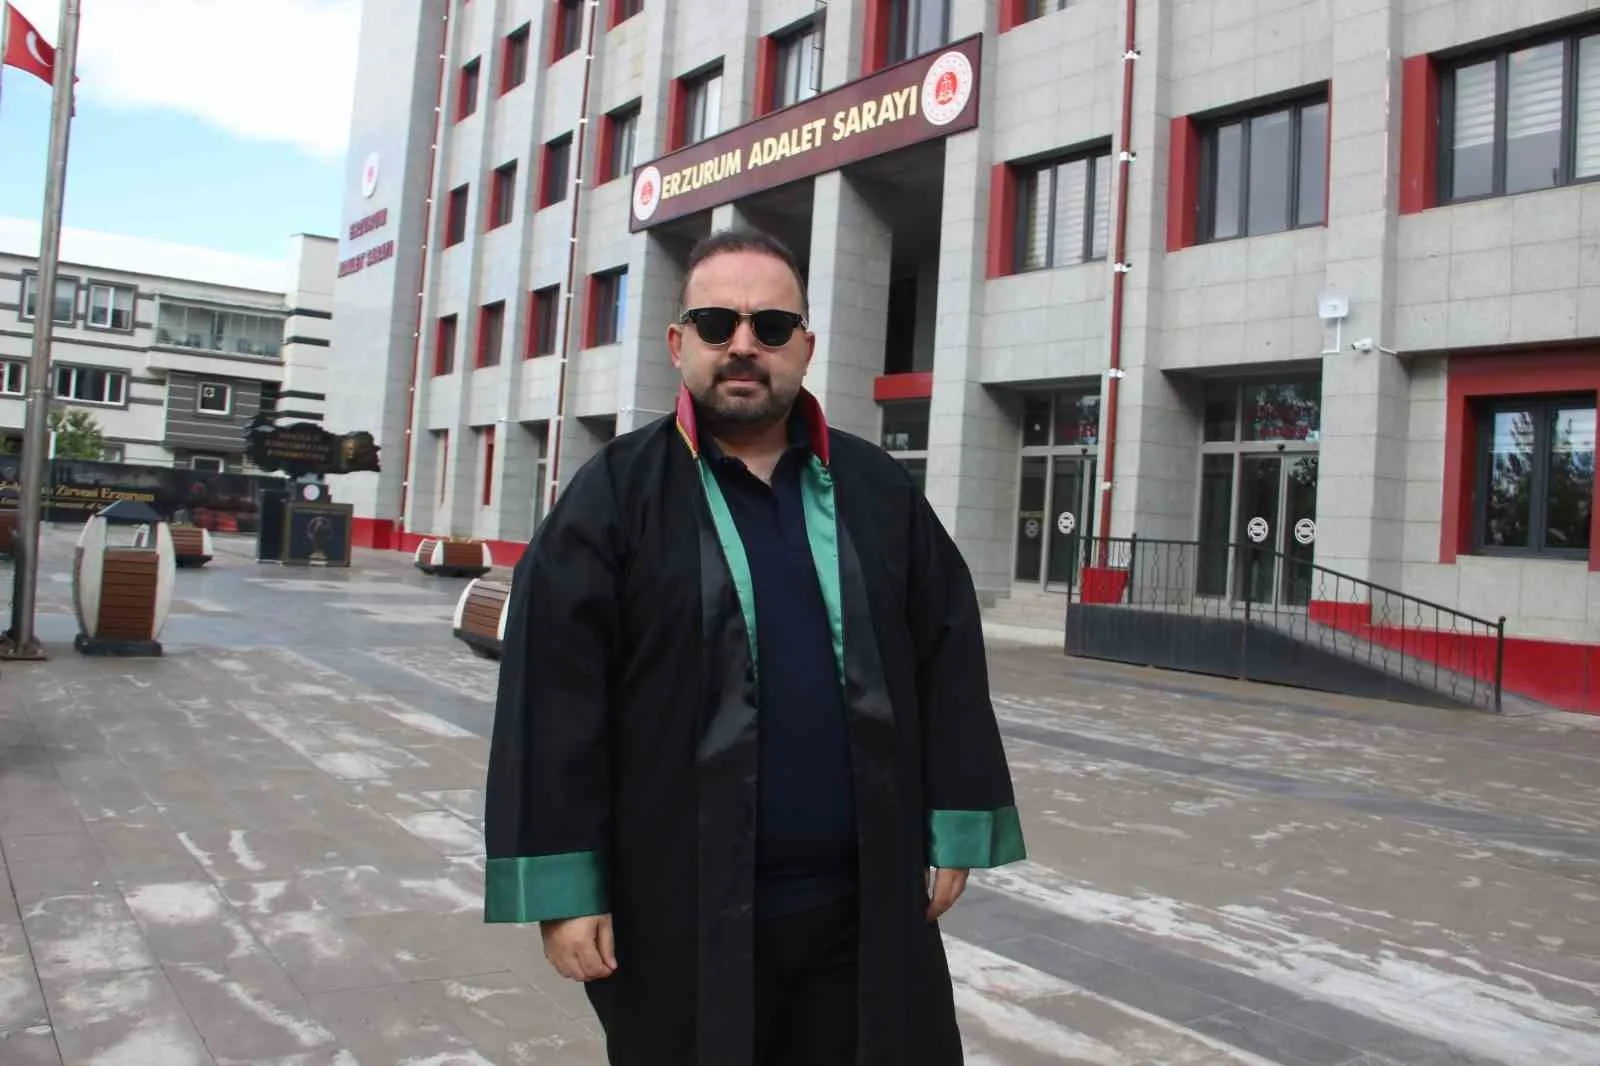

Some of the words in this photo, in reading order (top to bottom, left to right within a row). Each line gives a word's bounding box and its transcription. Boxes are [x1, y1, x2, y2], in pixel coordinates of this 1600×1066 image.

[660, 148, 742, 200] ERZURUM
[747, 117, 827, 170] ADALET
[831, 85, 918, 142] SARAYI
